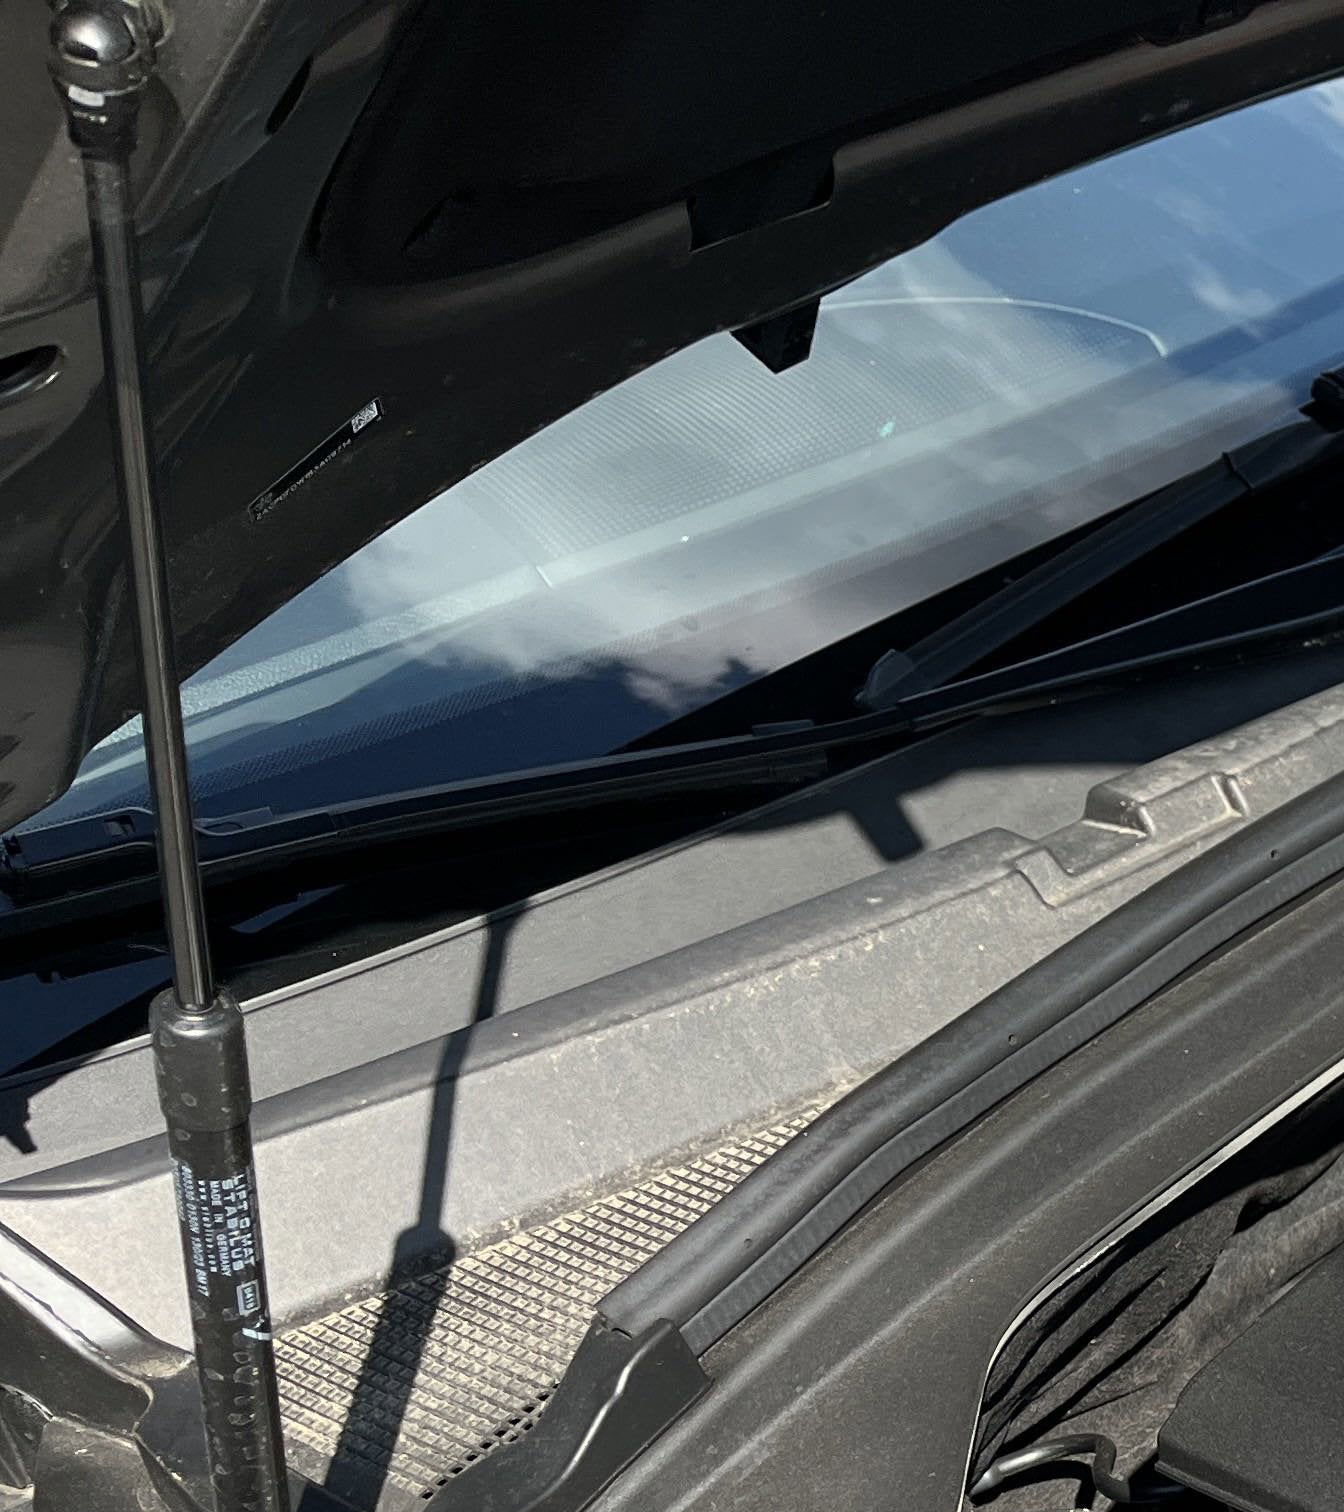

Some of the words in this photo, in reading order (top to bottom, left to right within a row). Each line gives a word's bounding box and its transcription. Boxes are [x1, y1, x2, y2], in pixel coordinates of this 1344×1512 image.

[209, 1180, 223, 1206] MADE
[213, 1213, 224, 1223] IN
[222, 1178, 245, 1272] STABILUS
[216, 1233, 232, 1277] GERMANY
